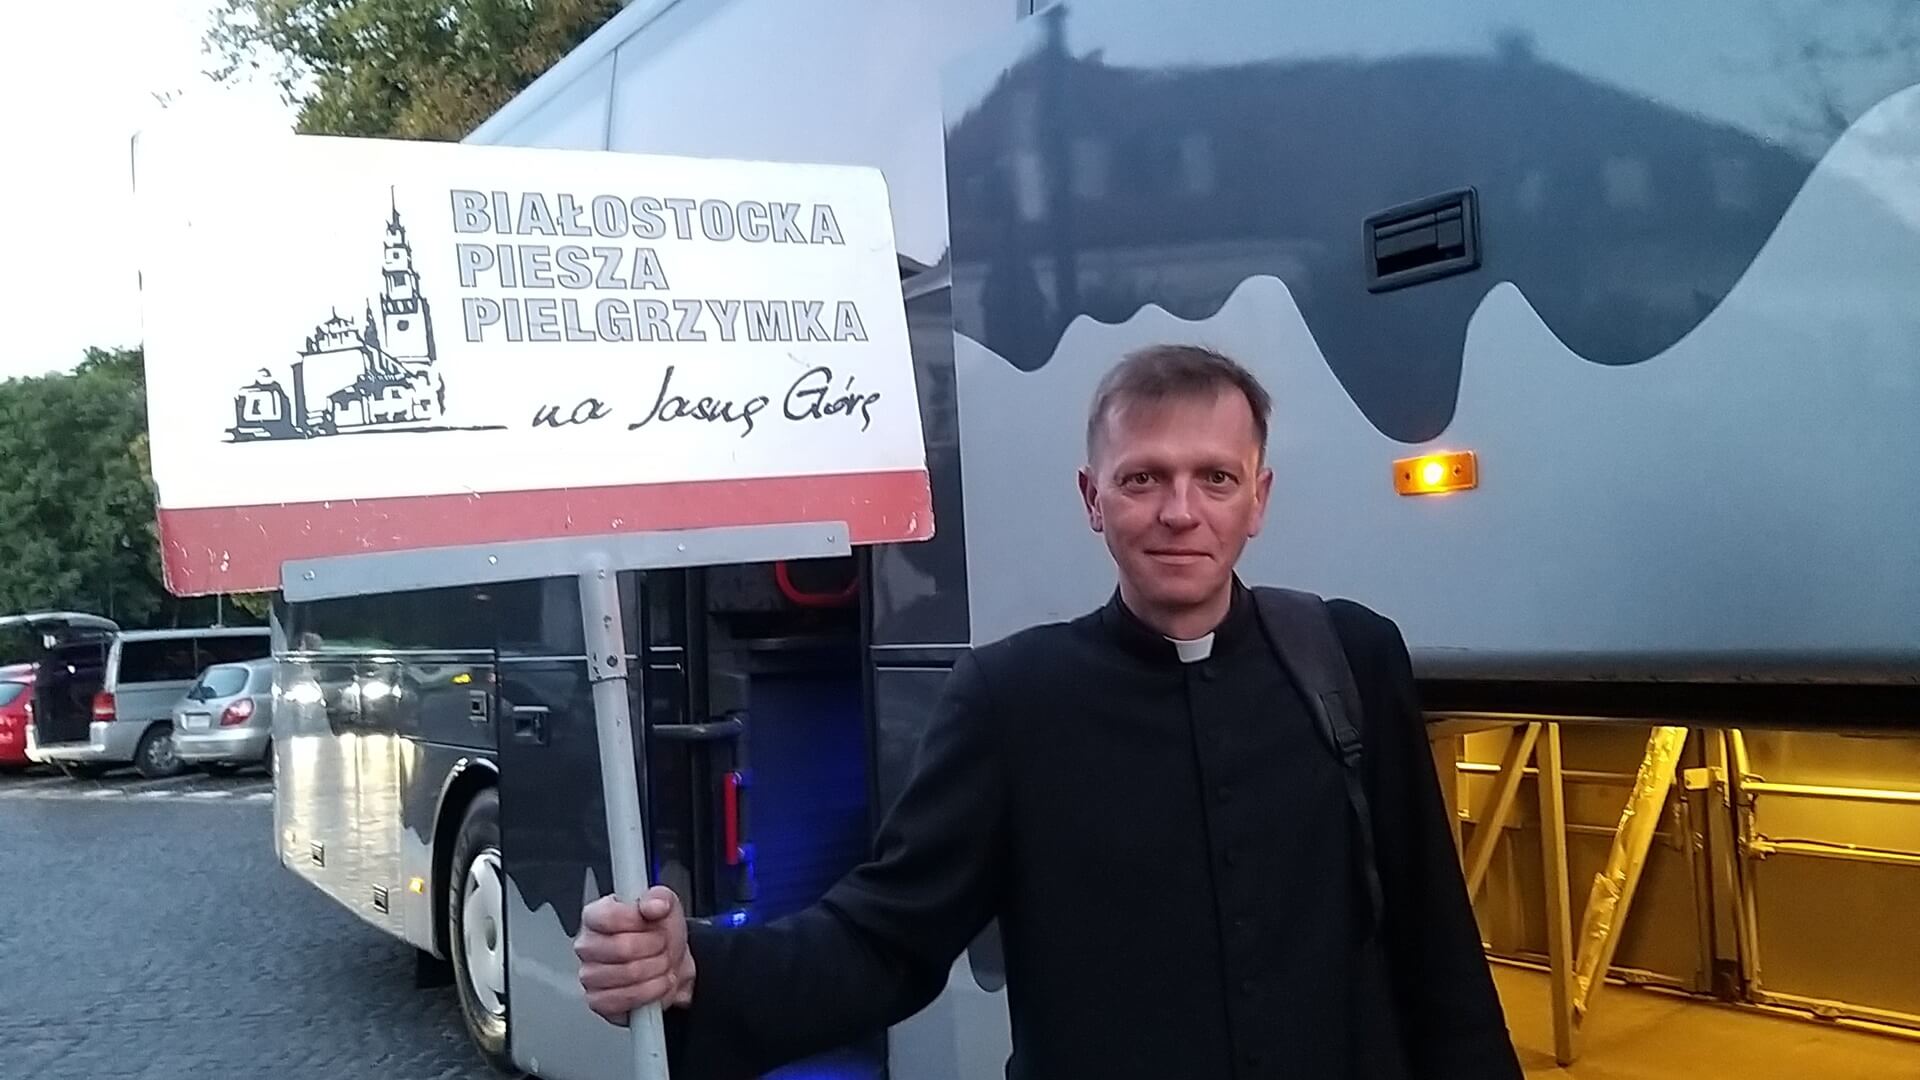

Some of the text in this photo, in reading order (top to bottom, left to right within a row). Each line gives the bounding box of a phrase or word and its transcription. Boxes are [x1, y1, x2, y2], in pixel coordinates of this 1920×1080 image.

[450, 189, 845, 245] BIAŁOSTOCKA
[456, 243, 670, 290] PIESZA
[461, 297, 869, 343] PIELGRZYMKA
[532, 398, 612, 428] na
